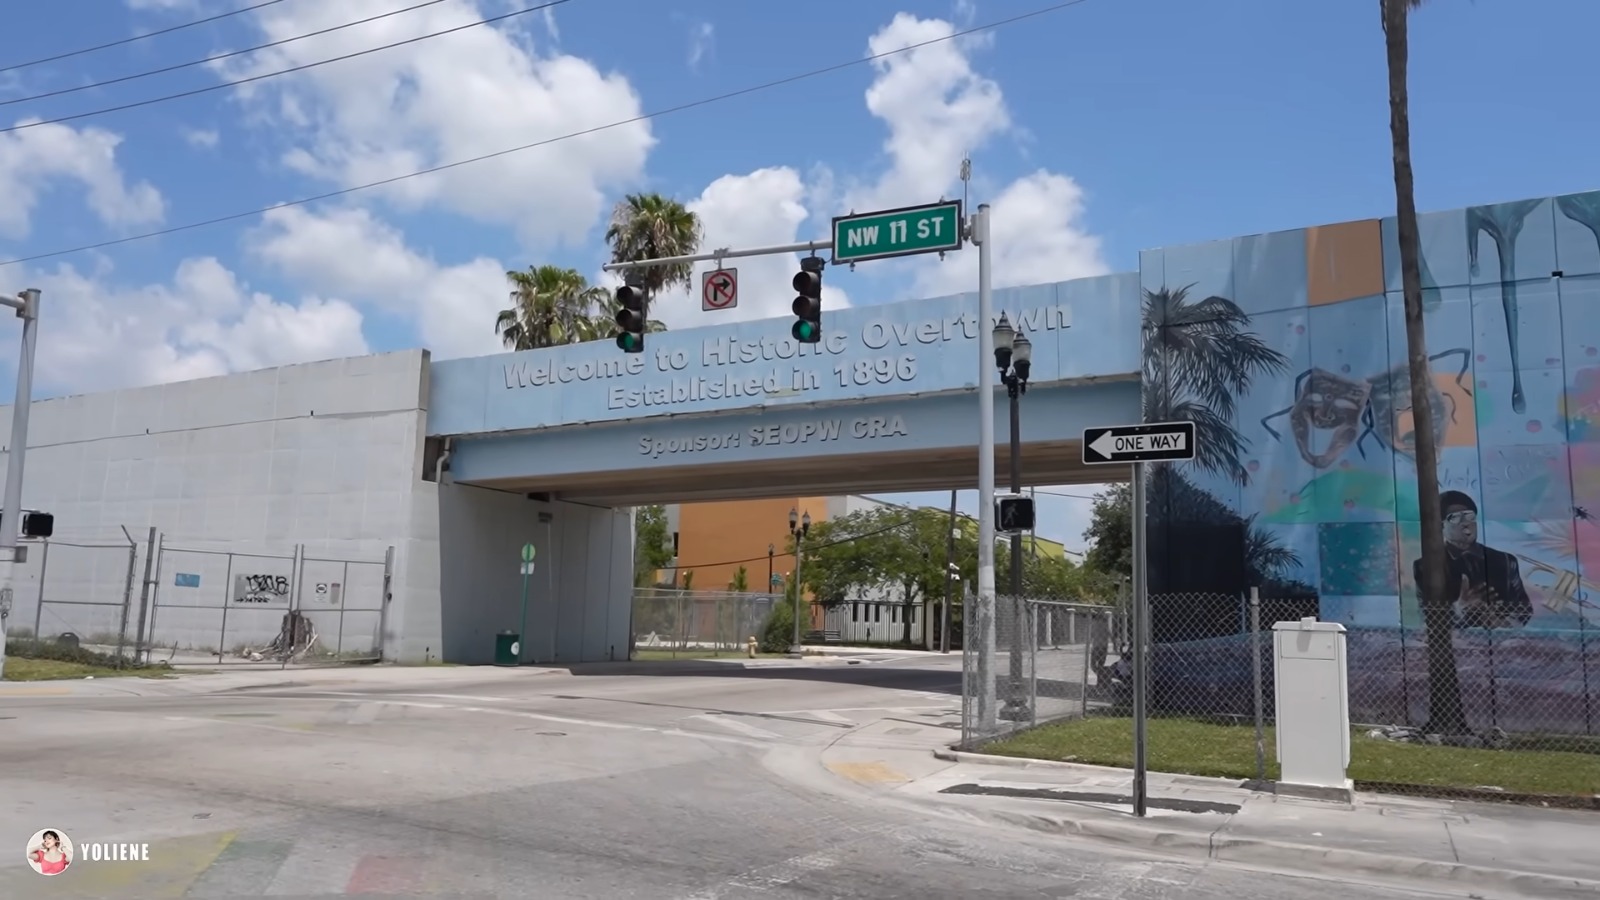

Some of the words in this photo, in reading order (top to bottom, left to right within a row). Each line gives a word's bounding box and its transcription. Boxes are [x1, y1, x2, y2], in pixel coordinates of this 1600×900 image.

[847, 225, 879, 248] NW
[889, 219, 907, 244] 11
[917, 216, 944, 239] ST
[504, 352, 645, 389] Welcome
[655, 347, 689, 372] to
[861, 304, 1073, 350] Overtwn
[607, 367, 779, 410] Established
[792, 366, 820, 391] in
[833, 353, 918, 388] 1896
[638, 431, 740, 459] Sponsor:
[748, 419, 842, 447] SEOPW
[851, 414, 908, 439] CRA
[1115, 437, 1144, 451] ONE
[1150, 434, 1181, 449] WAY
